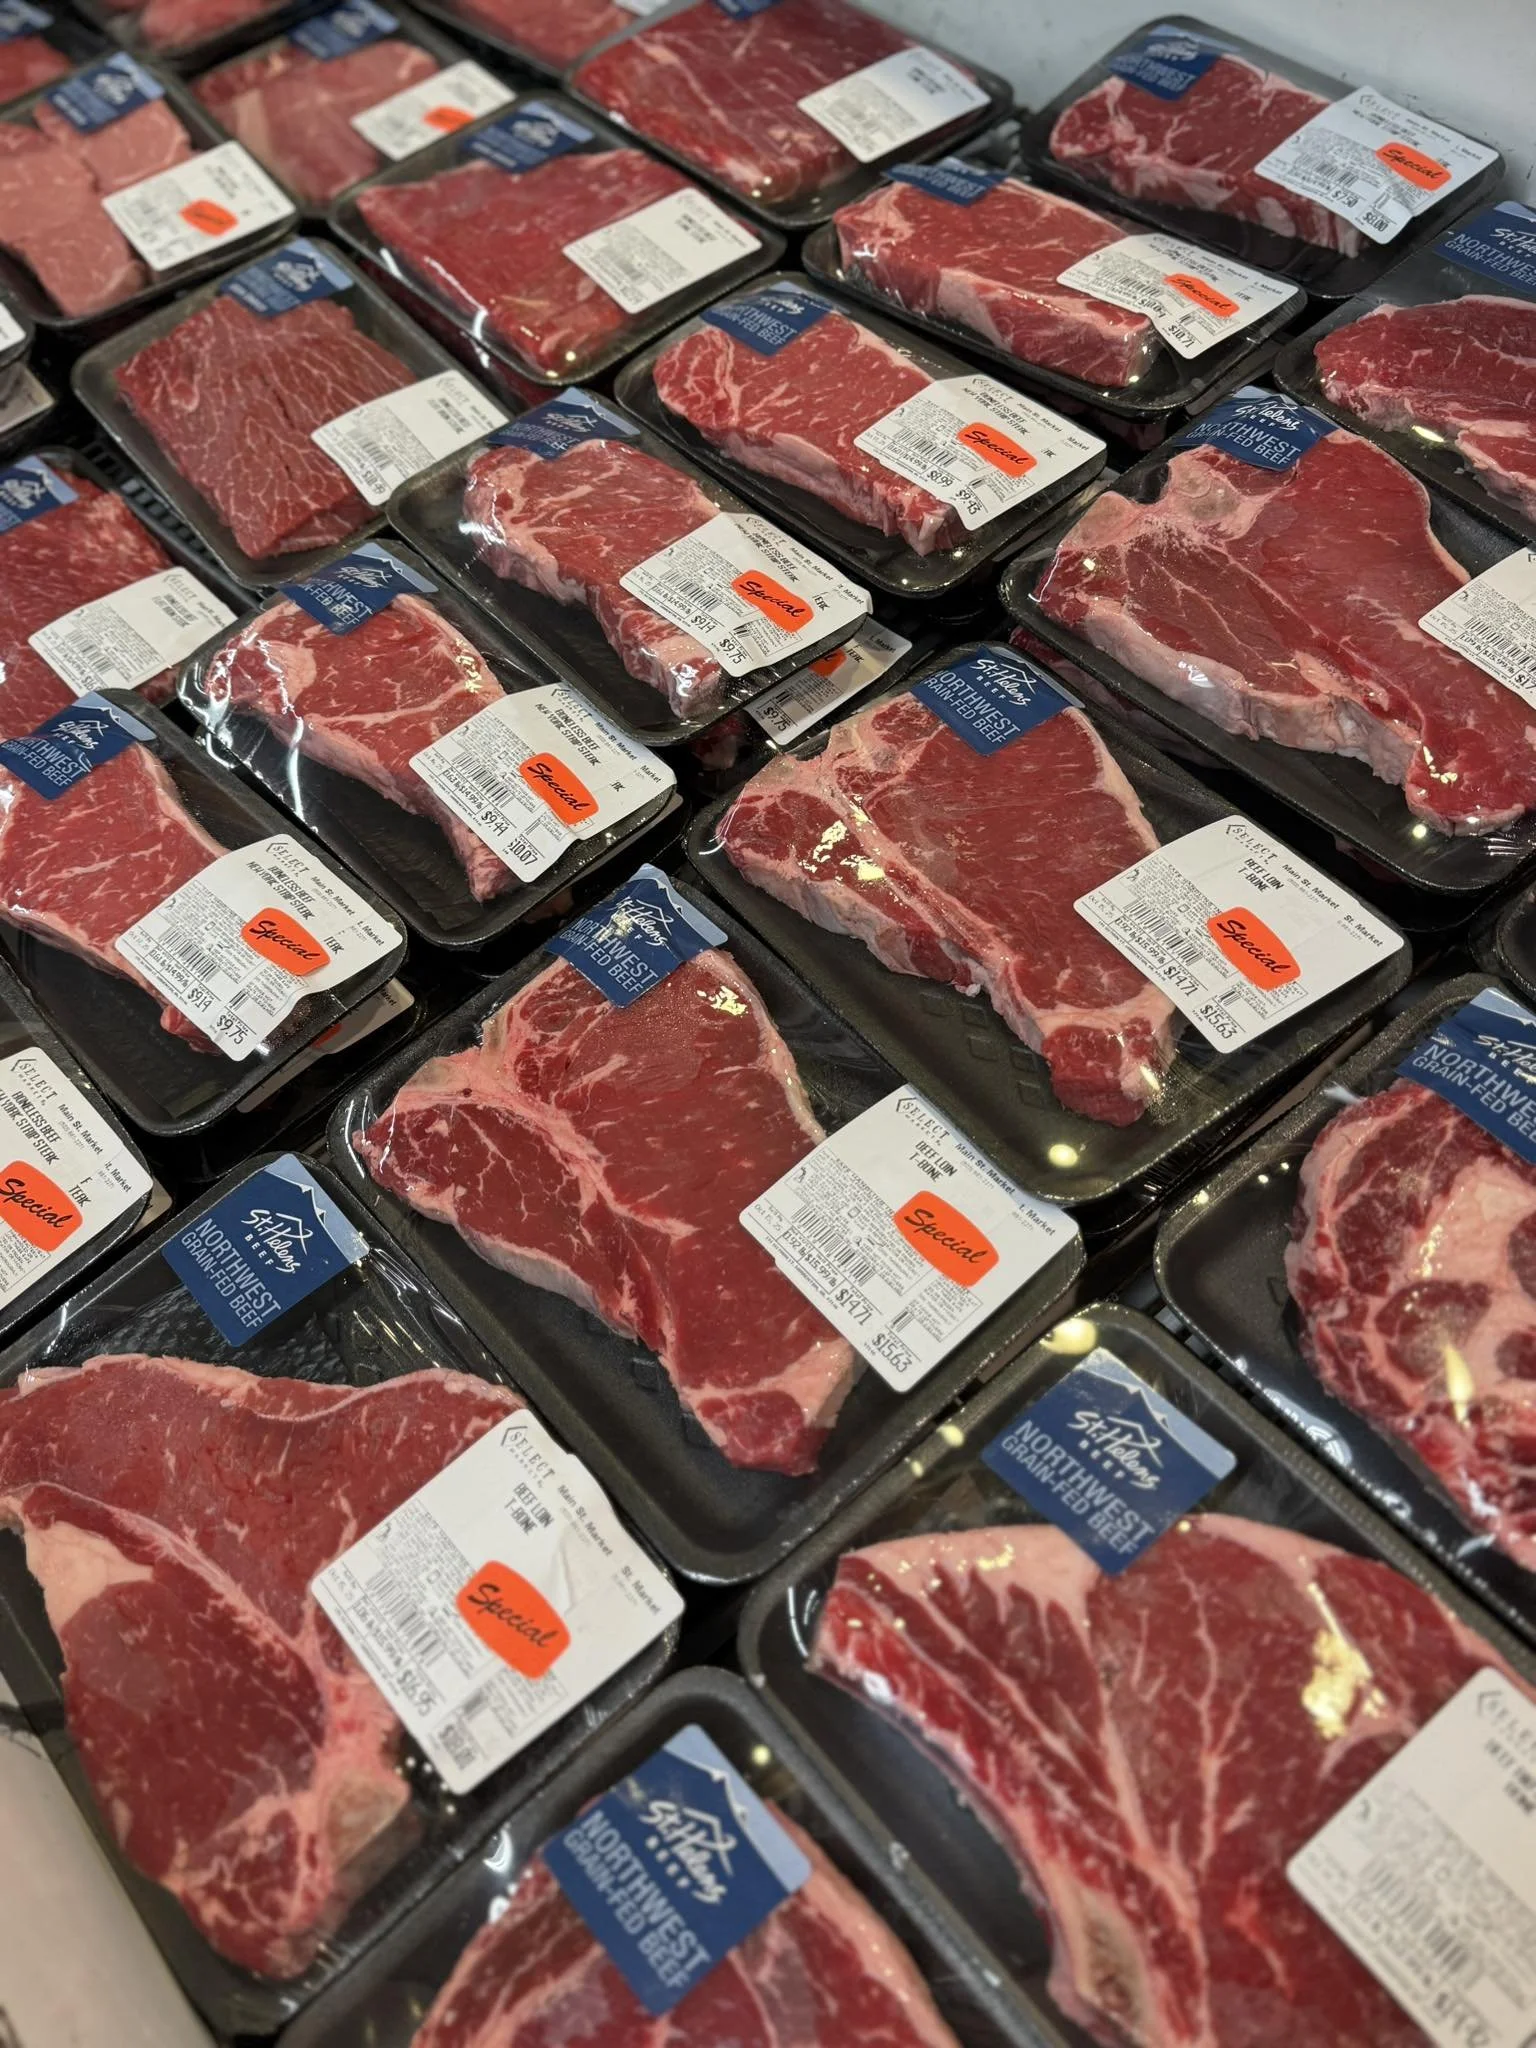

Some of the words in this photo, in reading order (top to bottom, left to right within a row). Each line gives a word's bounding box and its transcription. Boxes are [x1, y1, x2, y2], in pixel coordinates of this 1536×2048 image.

[1382, 150, 1442, 179] Special
[1444, 240, 1510, 272] GRAIN-FED
[1172, 277, 1232, 310] Special
[964, 431, 1029, 464] Special
[1253, 443, 1292, 466] BEEF
[927, 470, 953, 487] $8.99
[954, 488, 981, 515] $9.43
[329, 604, 360, 626] BEEF
[738, 580, 807, 620] Special
[691, 615, 716, 633] $9.14
[719, 638, 747, 665] $9.75
[970, 659, 1032, 707] St.Helens
[975, 675, 1007, 700] BEEF
[763, 706, 791, 732] $9.75
[923, 677, 976, 720] RAIN-FED
[972, 718, 1007, 744] BEEF
[552, 708, 587, 738] BONELESS
[581, 736, 600, 750] BEEF
[617, 742, 637, 760] Market
[42, 765, 72, 787] BEEF
[527, 763, 590, 811] Special
[640, 765, 661, 783] Market
[481, 811, 508, 837] $9.44
[1232, 825, 1278, 859] SELECT
[273, 842, 310, 873] SELECT
[1244, 858, 1267, 874] BEEF
[1262, 873, 1284, 890] LOIN
[267, 866, 301, 892] BONELESS
[295, 890, 315, 903] BEEF
[311, 876, 326, 889] Main
[333, 896, 355, 916] Market
[1238, 867, 1270, 892] T-BONE
[1282, 864, 1301, 879] Main
[1301, 879, 1311, 888] St.
[1312, 887, 1340, 909] Market
[290, 900, 315, 920] STEAK
[1114, 918, 1132, 932] 0.92
[249, 920, 320, 960] Special
[362, 925, 384, 946] Market
[1216, 920, 1291, 973] Special
[1344, 915, 1354, 925] St.
[1355, 924, 1383, 947] Market
[608, 963, 646, 994] BEEF
[1163, 966, 1198, 996] $14.71
[187, 988, 212, 1012] $9.14
[217, 1015, 248, 1044] $9.75
[1200, 1005, 1237, 1039] $15.63
[19, 1059, 58, 1099] SELECT
[1411, 1056, 1507, 1114] GRAIN-FED
[11, 1091, 47, 1127] BONELESS
[40, 1122, 61, 1143] BEEF
[58, 1104, 74, 1122] Main
[72, 1121, 82, 1132] St.
[81, 1130, 103, 1155] Market
[903, 1099, 950, 1139] SELECT
[16, 1118, 40, 1139] STRIP
[33, 1139, 60, 1165] STEAK
[915, 1140, 939, 1159] BEEF
[934, 1157, 957, 1176] LOIN
[110, 1168, 131, 1192] Market
[909, 1152, 943, 1181] T-BONE
[955, 1143, 975, 1161] Main
[975, 1160, 986, 1171] St.
[987, 1169, 1015, 1195] Market
[0, 1178, 73, 1228] Special
[780, 1229, 802, 1249] 0.92
[904, 1208, 988, 1263] Special
[1026, 1209, 1056, 1236] Market
[241, 1209, 307, 1273] St.Helens
[245, 1233, 274, 1265] BEEF
[181, 1232, 236, 1297] GRAIN-FED
[229, 1294, 263, 1327] BEEF
[193, 1218, 281, 1317] NORTHWEST
[801, 1251, 837, 1287] $15.99/lb
[835, 1289, 872, 1326] $14.71
[872, 1333, 912, 1373] $15.63
[510, 1427, 556, 1479] SELECT
[1068, 1411, 1162, 1489] St.Helens
[1079, 1439, 1125, 1478] BEEF
[1001, 1435, 1090, 1514] GRAIN-FED
[1088, 1512, 1134, 1552] BEEF
[1015, 1420, 1155, 1544] NORTHWEST
[506, 1499, 536, 1533] T-BONE
[513, 1482, 537, 1505] BEEF
[531, 1504, 553, 1527] LOIN
[558, 1485, 576, 1507] Main
[576, 1506, 587, 1522] St.
[585, 1521, 613, 1556] Market
[621, 1566, 632, 1578] St.
[632, 1580, 660, 1614] Market
[467, 1583, 558, 1647] Special
[397, 1670, 436, 1716] $16.95
[640, 1800, 731, 1903] St.Helens
[564, 1829, 645, 1934] GRAIN-FED
[639, 1931, 687, 1986] BEEF
[581, 1811, 709, 1971] NORTHWEST
